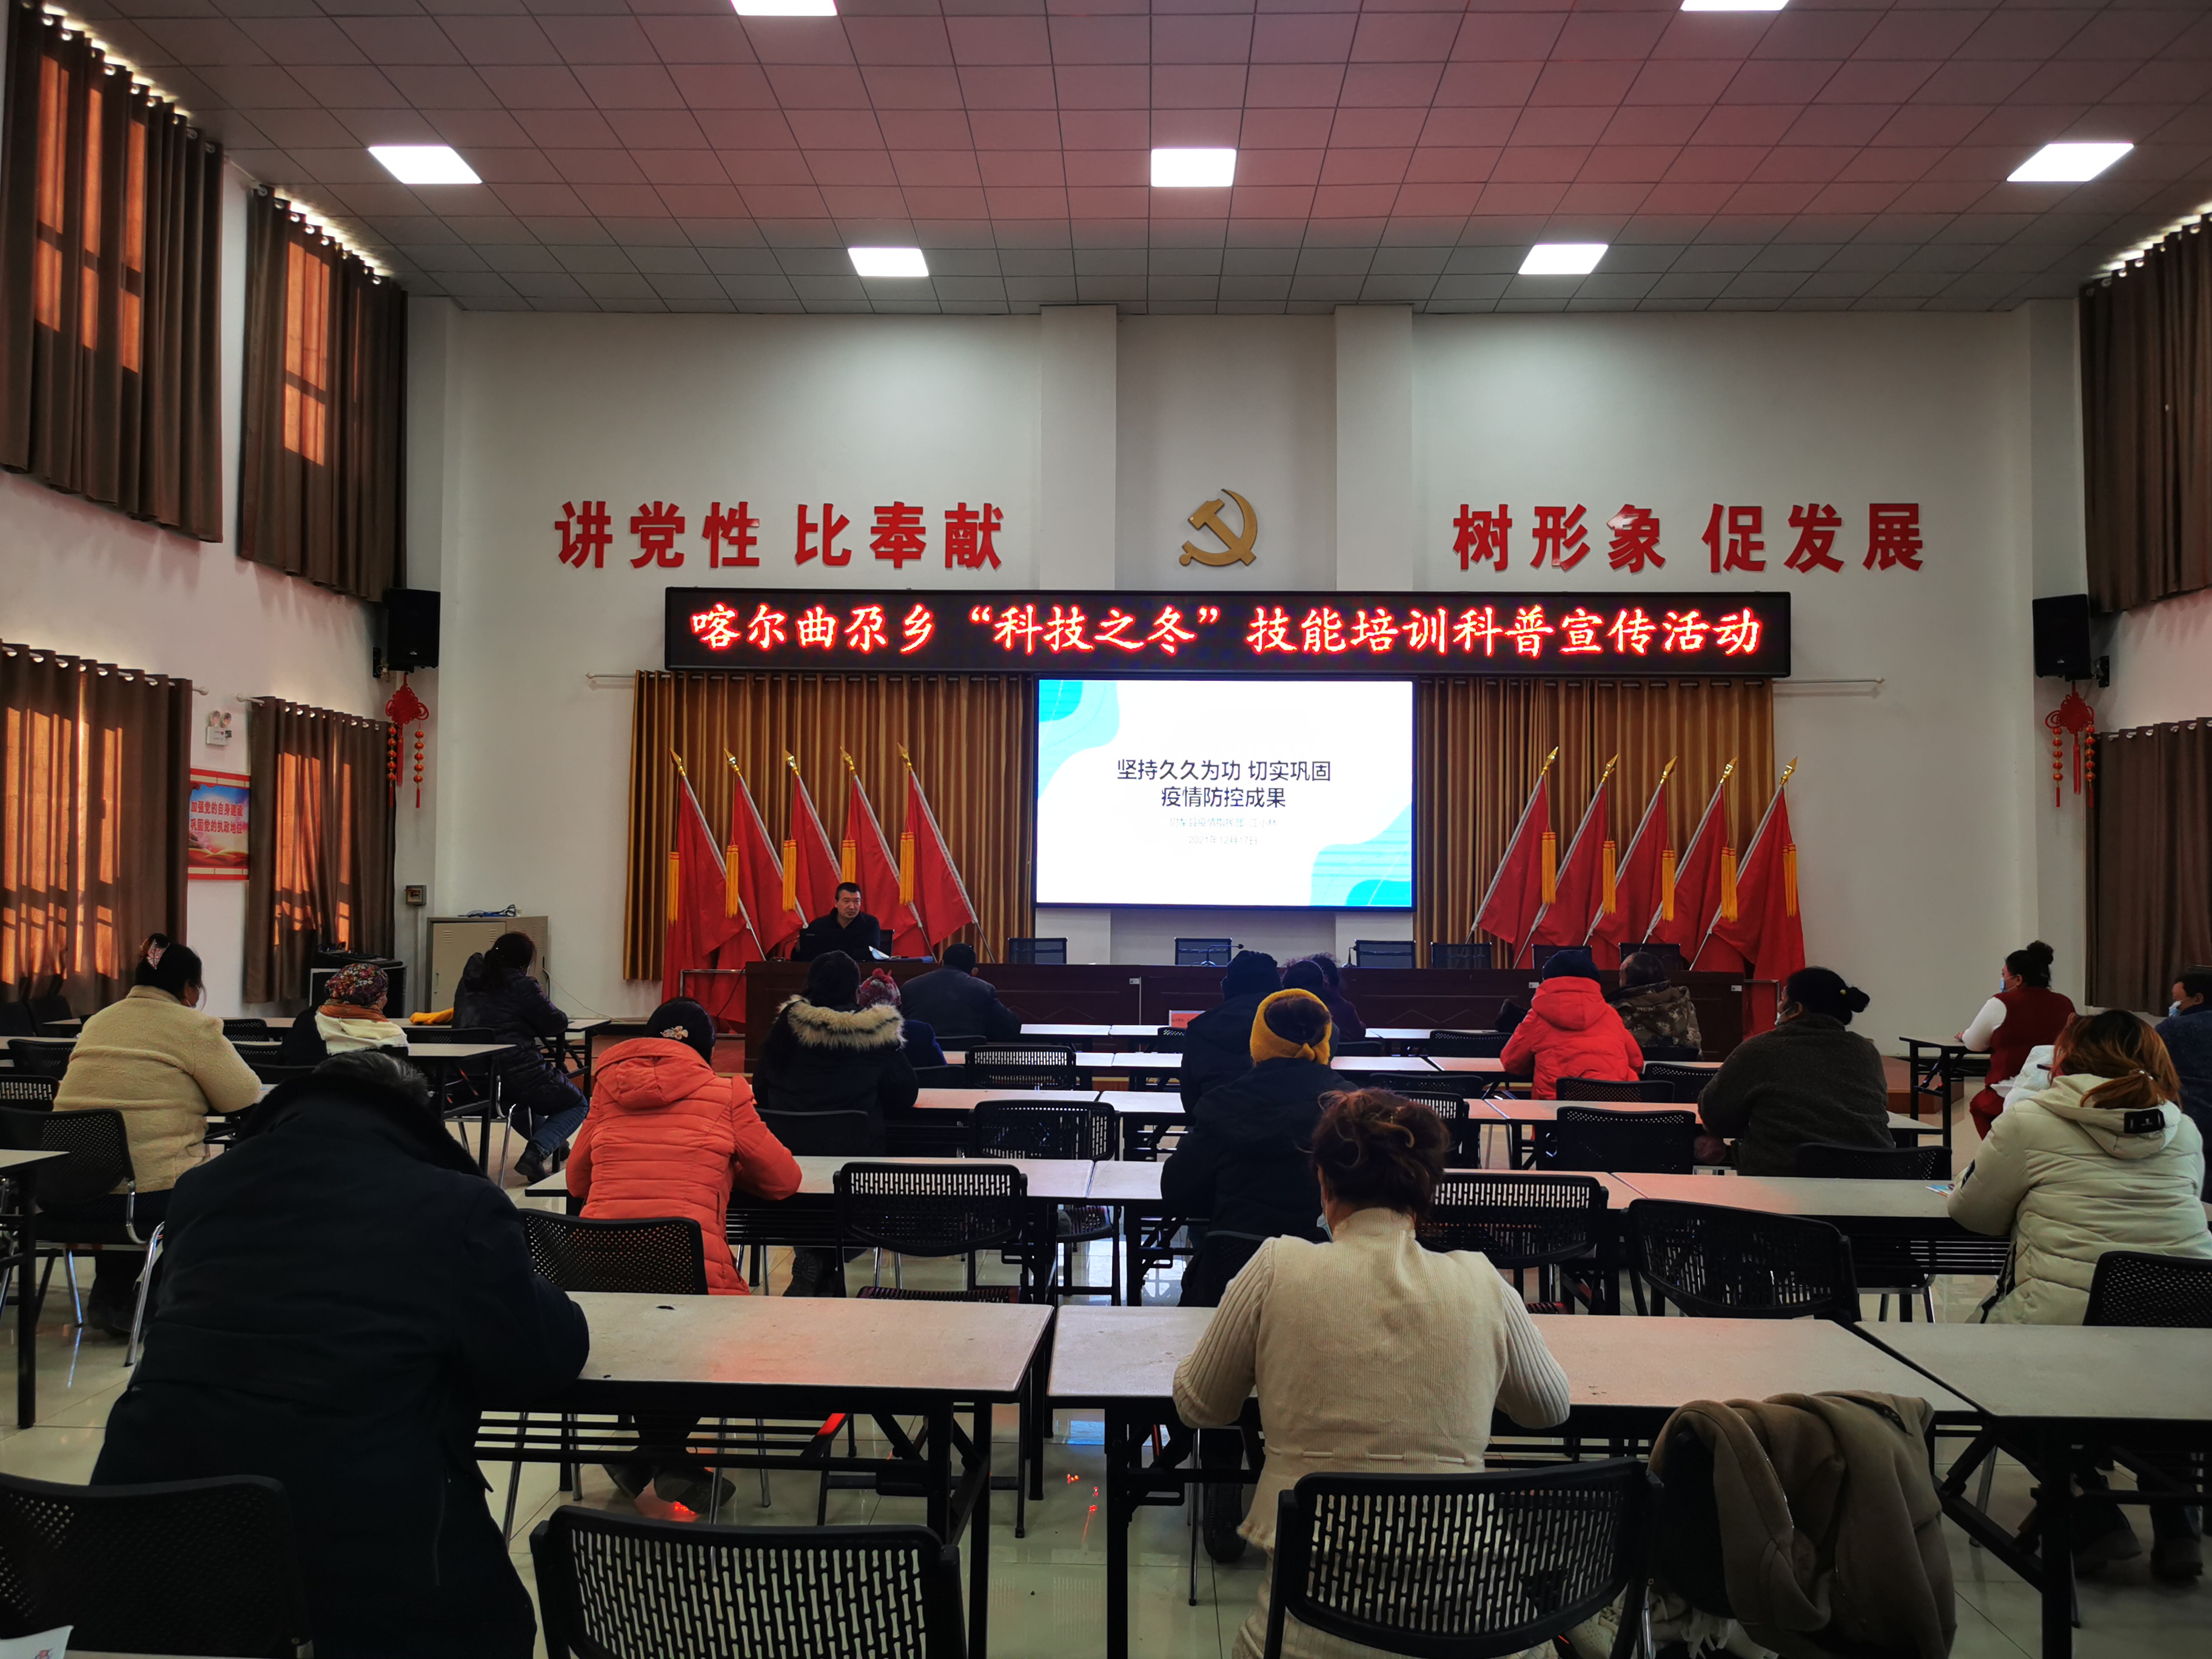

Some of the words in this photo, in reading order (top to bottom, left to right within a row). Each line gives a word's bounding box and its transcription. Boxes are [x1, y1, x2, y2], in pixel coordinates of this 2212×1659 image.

[554, 501, 760, 569] 讲党性
[794, 501, 1003, 569] 比奉献
[1453, 504, 1666, 573] 树形象
[1702, 503, 1924, 572] 促发展
[690, 602, 935, 654] 喀尔曲尕乡
[969, 603, 1221, 655] “科技之冬”
[1244, 605, 1763, 659] 技能培训科普宣传活动
[1117, 759, 1241, 782] 坚持久久为功
[1248, 760, 1331, 782] 切实巩固
[190, 800, 243, 817] 加强党的自身建设
[1161, 786, 1285, 808] 疫情防控成果
[190, 819, 243, 835] 巩固党的执政地位
